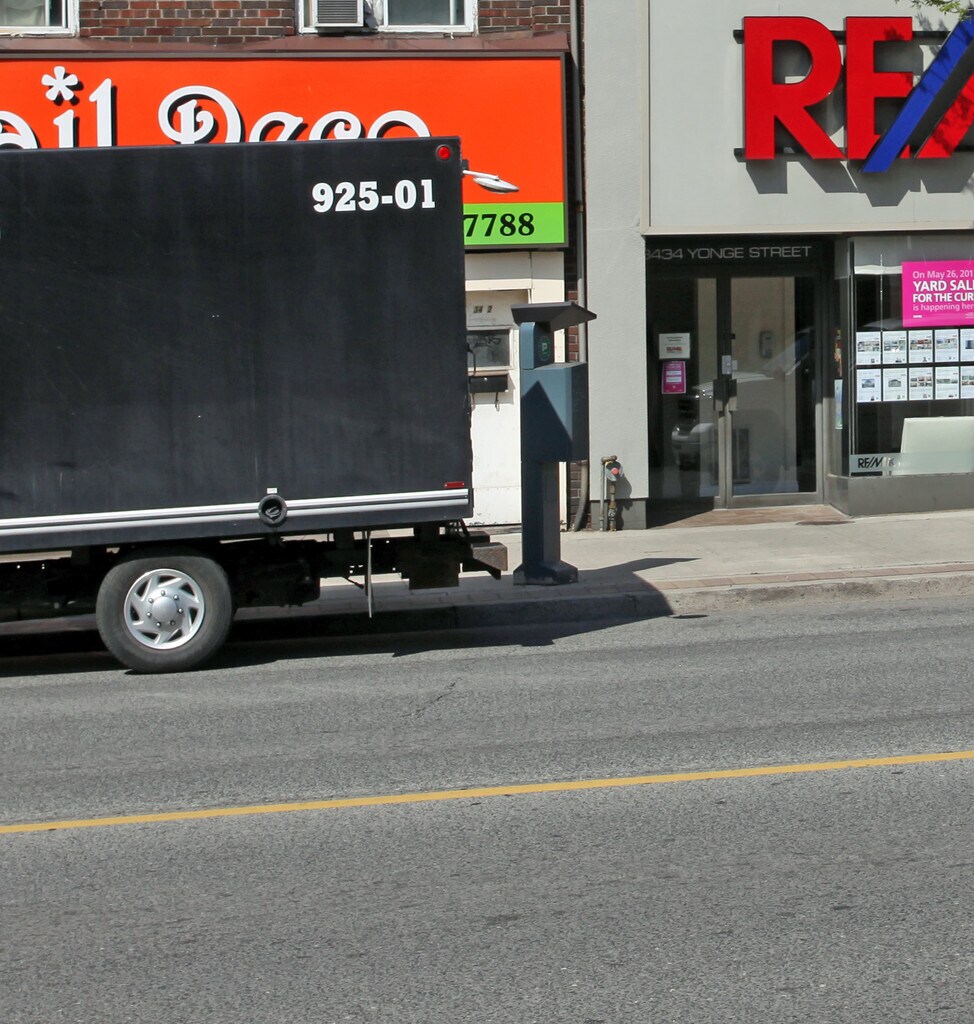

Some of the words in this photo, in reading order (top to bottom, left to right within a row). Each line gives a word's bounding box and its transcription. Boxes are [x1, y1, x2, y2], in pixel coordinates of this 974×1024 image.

[0, 66, 112, 149] il
[312, 179, 436, 212] 925-01
[463, 213, 535, 237] 7788
[687, 247, 744, 259] YONGE
[749, 246, 812, 258] STREET
[912, 271, 925, 279] On
[927, 270, 945, 280] May
[946, 270, 958, 279] 26,
[912, 280, 947, 292] YARD
[912, 293, 933, 303] FOR
[934, 292, 953, 302] THE
[920, 303, 960, 313] happening
[857, 457, 895, 468] RE/M
